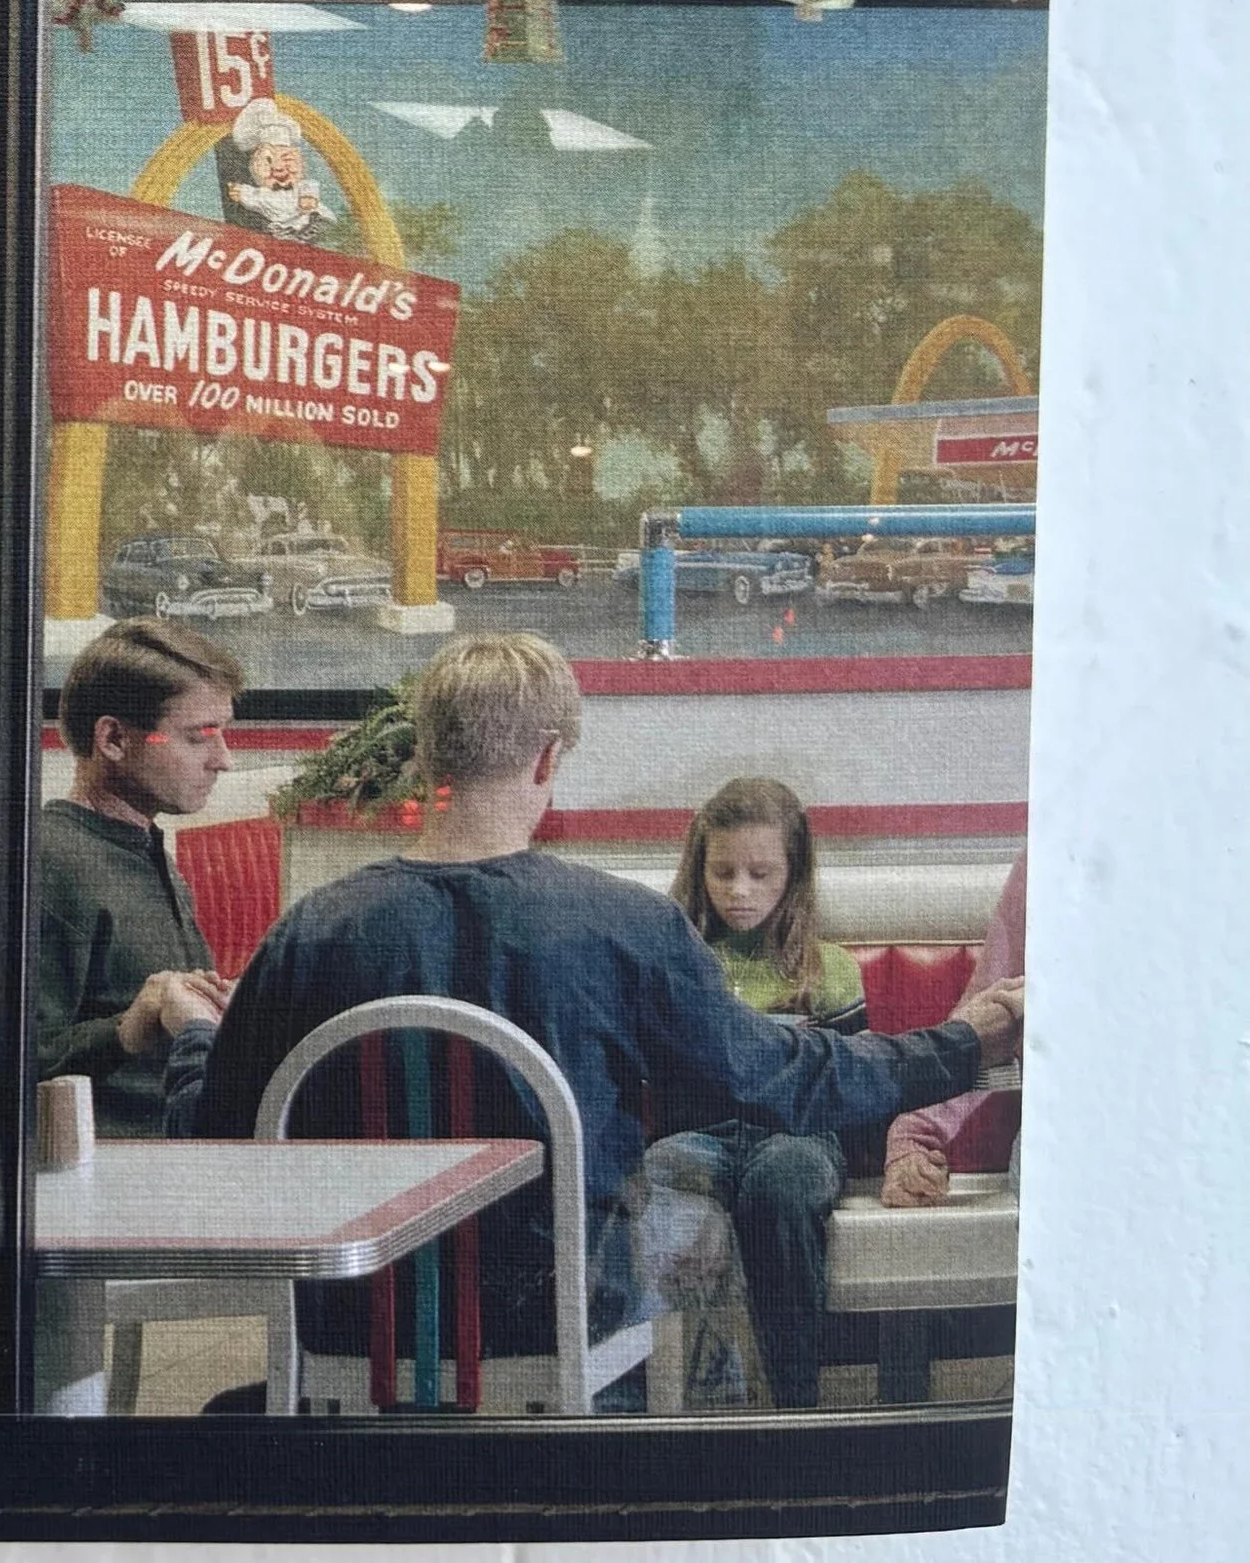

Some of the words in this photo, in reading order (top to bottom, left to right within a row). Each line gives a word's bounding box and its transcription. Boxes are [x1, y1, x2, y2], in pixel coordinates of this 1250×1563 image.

[85, 226, 151, 250] LICENSEE
[108, 245, 128, 258] OF
[154, 230, 417, 321] McDonald's
[163, 279, 217, 299] SPEEDY
[225, 291, 291, 313] SERVICE
[299, 305, 359, 325] SYSTEM
[87, 287, 440, 404] HAMBURGERS
[123, 379, 178, 405] OVER
[188, 379, 240, 411] 100
[245, 394, 334, 422] MILLION
[341, 405, 400, 429] SOLD
[990, 440, 1038, 458] Mc
